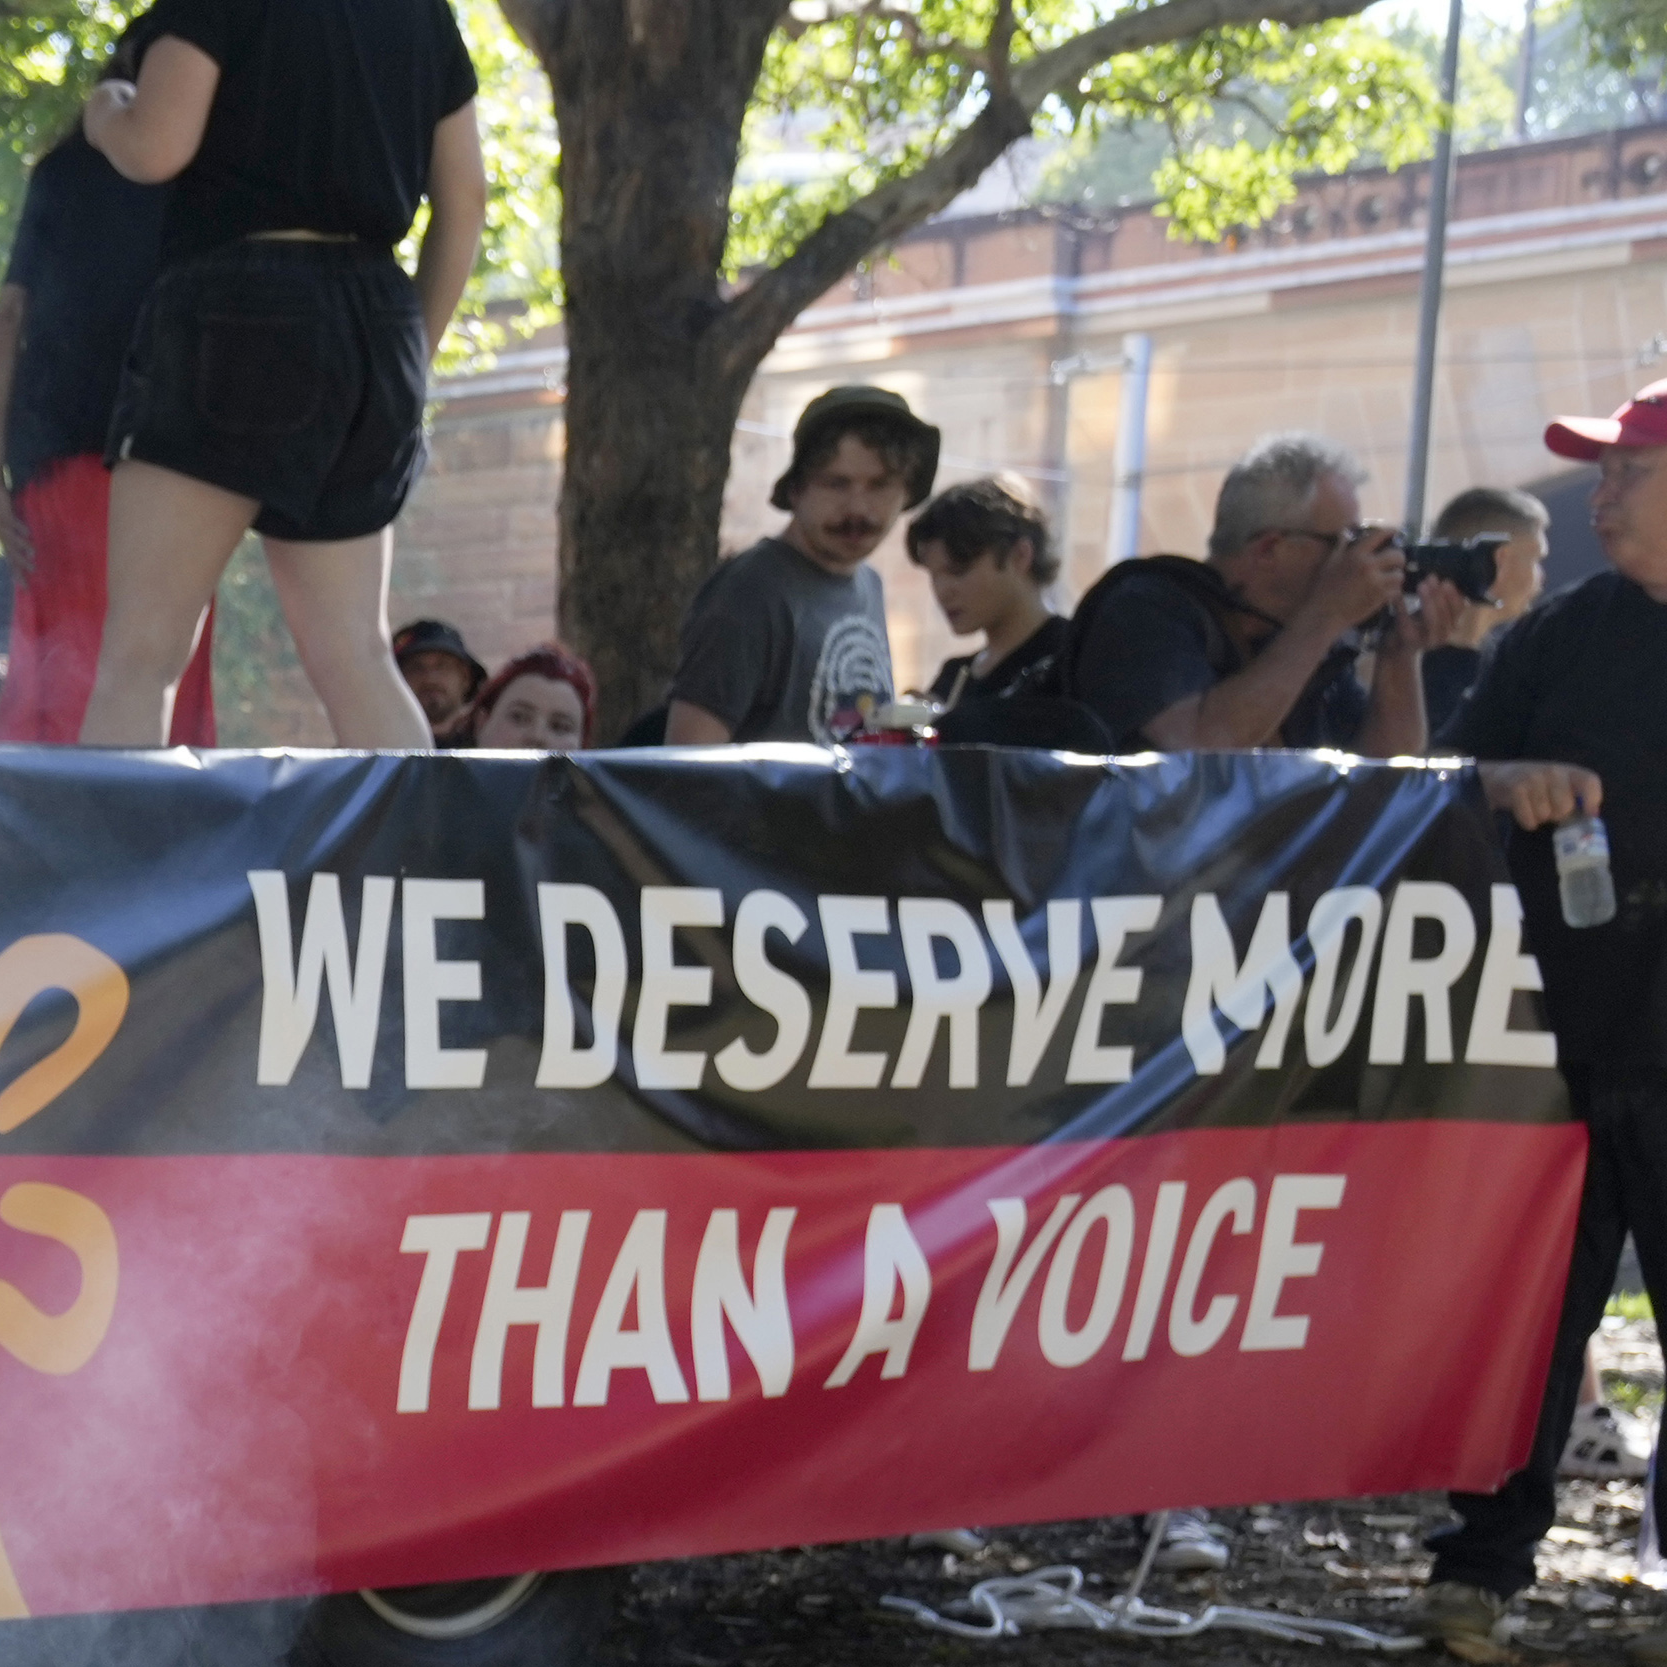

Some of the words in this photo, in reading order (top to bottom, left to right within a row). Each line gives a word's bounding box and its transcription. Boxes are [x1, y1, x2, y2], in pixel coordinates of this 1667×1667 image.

[246, 869, 489, 1090] WE
[534, 881, 1164, 1091] DESERVE
[1181, 881, 1559, 1076] MORE
[396, 1207, 797, 1414] THAN
[824, 1202, 933, 1388] A
[967, 1173, 1347, 1372] VOICE
